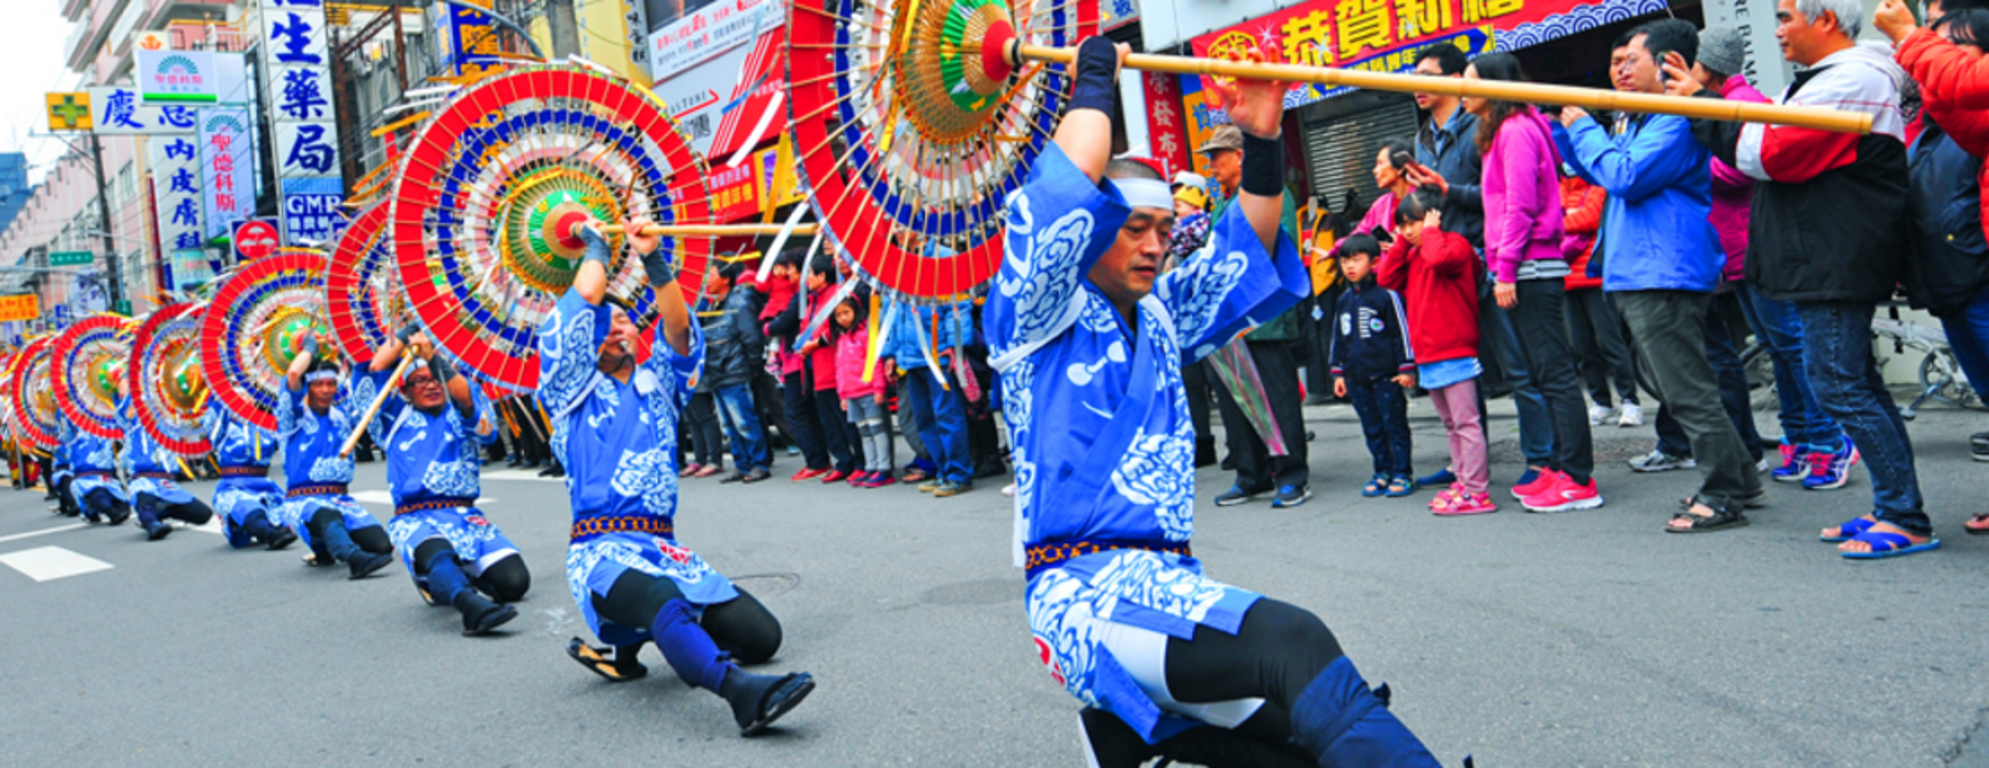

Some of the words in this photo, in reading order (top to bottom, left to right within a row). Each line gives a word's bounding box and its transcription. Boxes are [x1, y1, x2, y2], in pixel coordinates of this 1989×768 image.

[270, 0, 335, 174] 生藥局
[287, 195, 341, 214] GMP
